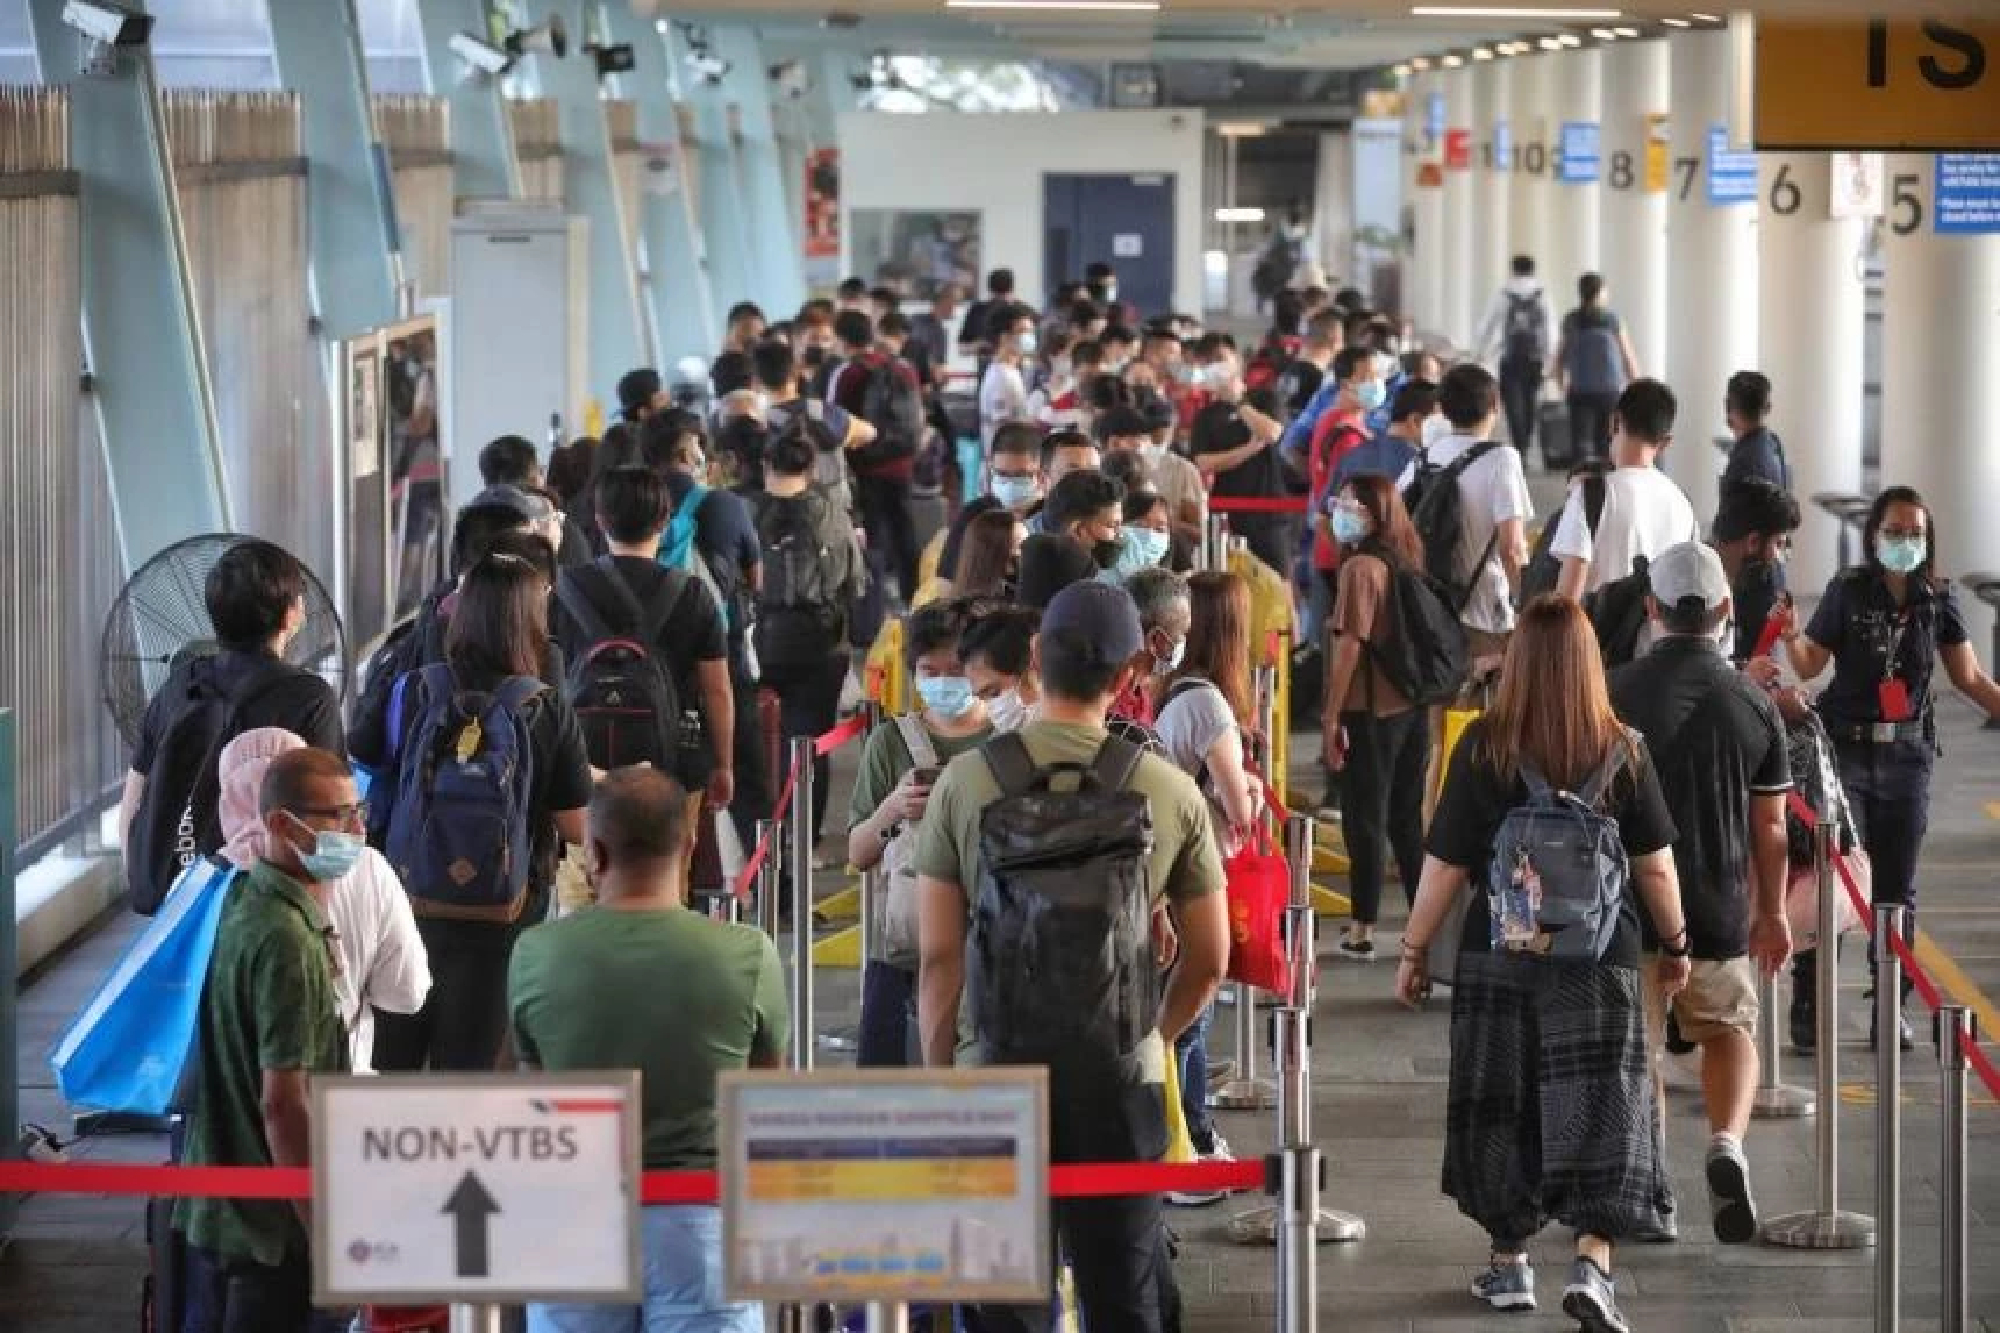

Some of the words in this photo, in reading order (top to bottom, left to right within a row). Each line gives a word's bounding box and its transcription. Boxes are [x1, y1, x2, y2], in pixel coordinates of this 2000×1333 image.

[1513, 142, 1545, 174] 10
[1609, 150, 1634, 190] 8
[1674, 157, 1700, 201] 7
[1770, 164, 1801, 214] 6
[1892, 174, 1923, 235] 5
[363, 1126, 578, 1164] NON-VTBS
